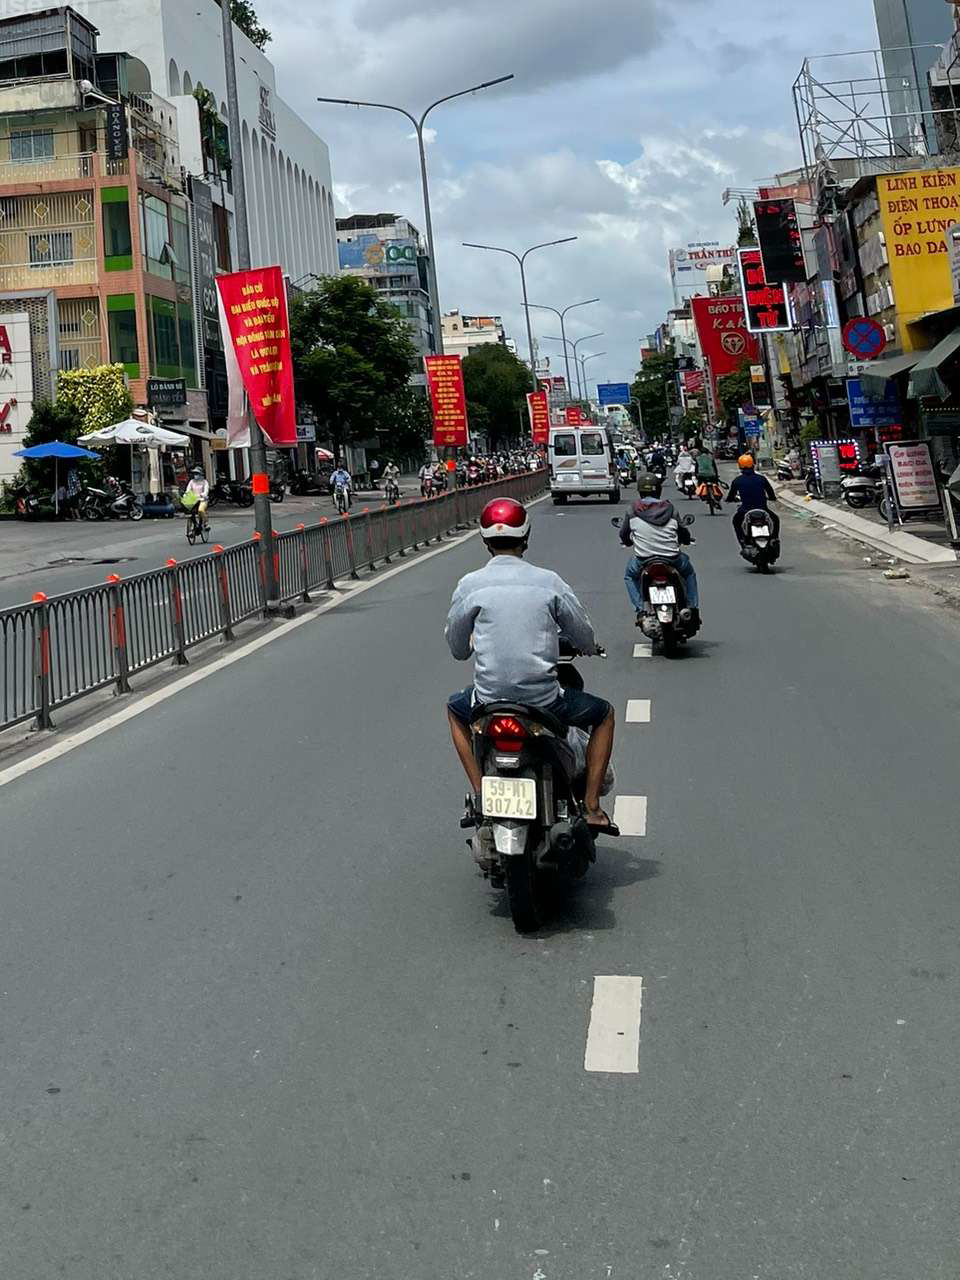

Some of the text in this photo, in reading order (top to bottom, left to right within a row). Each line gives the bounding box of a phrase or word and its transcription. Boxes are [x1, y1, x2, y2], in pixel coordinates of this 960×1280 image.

[886, 171, 956, 191] LINH KIỆN
[888, 195, 960, 215] ĐIỆN THOẠ
[893, 216, 912, 236] ỐP
[895, 240, 949, 256] BAO DA
[712, 318, 724, 329] K
